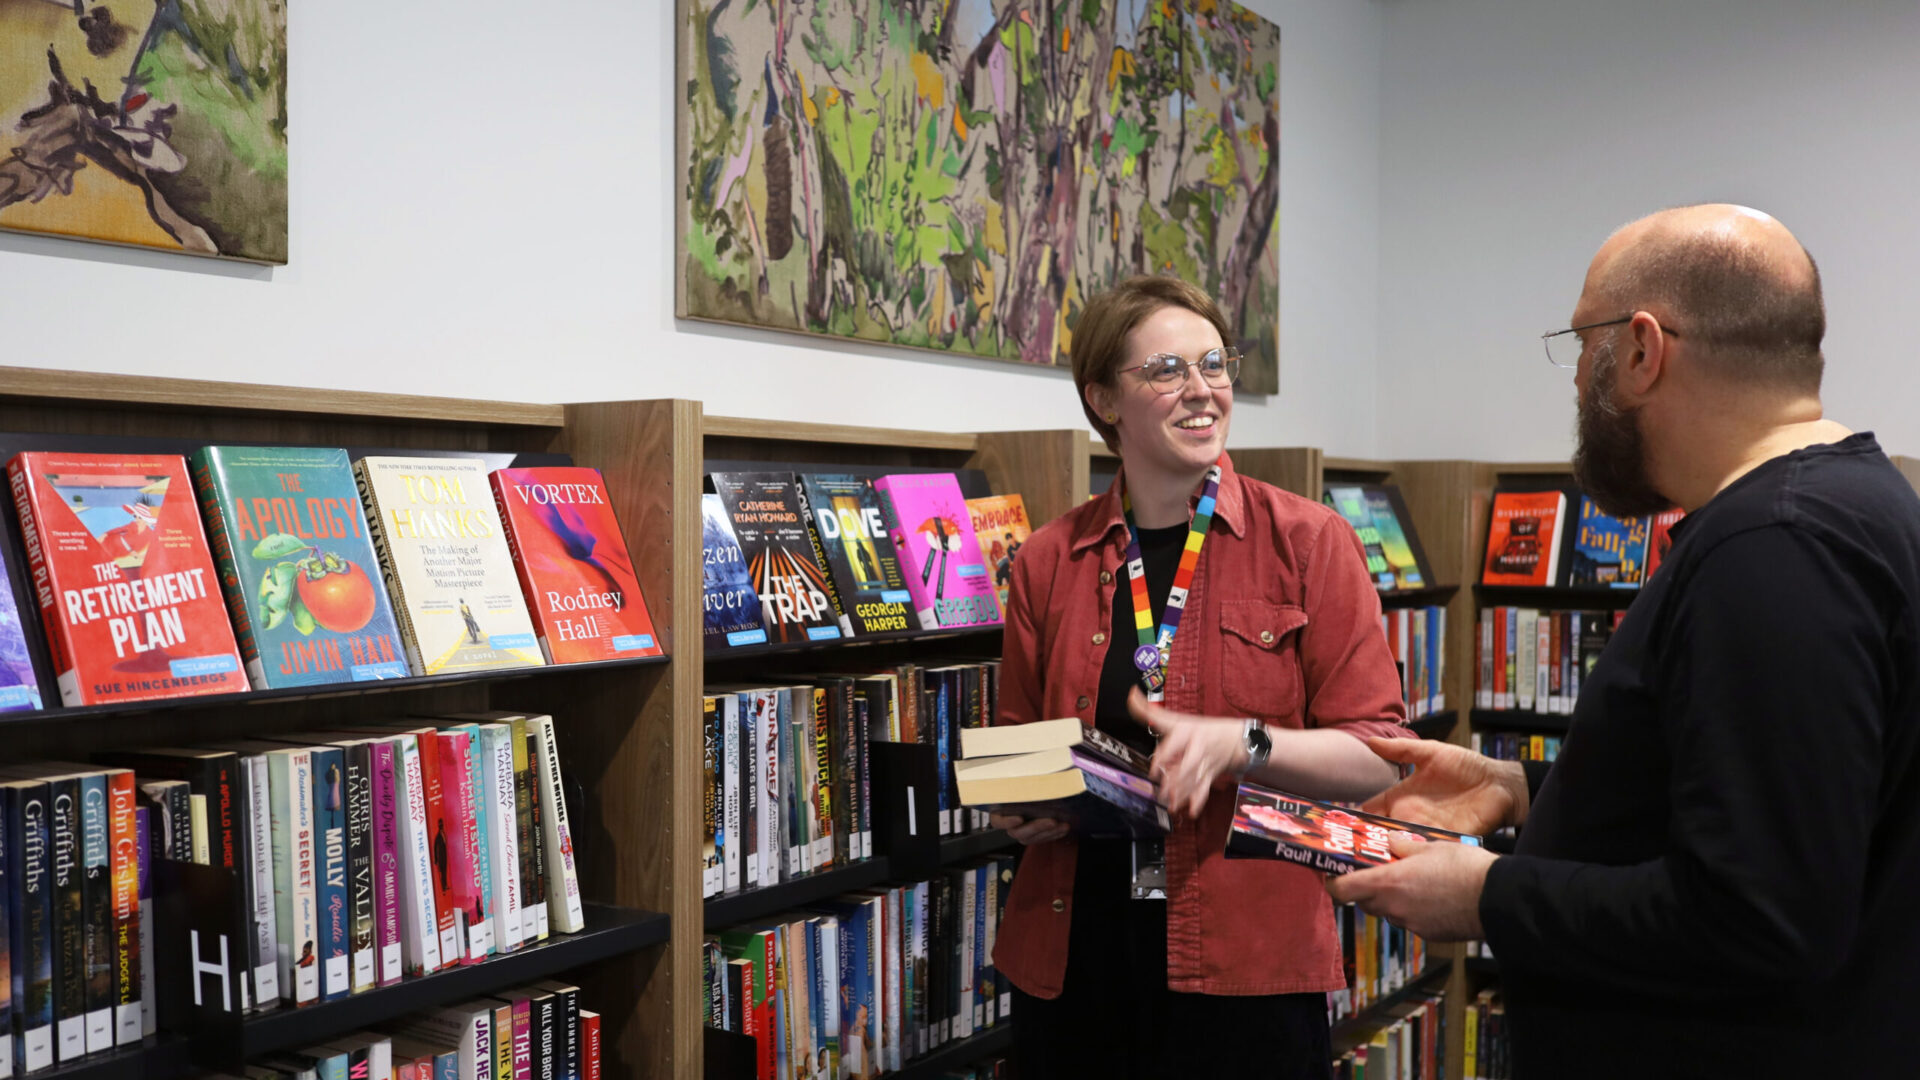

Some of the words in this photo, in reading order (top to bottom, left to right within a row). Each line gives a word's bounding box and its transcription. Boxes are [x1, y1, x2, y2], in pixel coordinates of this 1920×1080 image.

[276, 473, 304, 492] THE
[398, 475, 467, 505] TOM
[514, 484, 604, 505] VORTEX
[236, 498, 363, 541] APOLOGY
[390, 508, 494, 539] HANKS
[733, 512, 758, 524] RYAN
[758, 512, 798, 523] HOWARD
[739, 501, 786, 512] CATHERINE
[817, 508, 887, 539] DOVE
[972, 505, 1023, 533] EMBRACE
[1497, 507, 1556, 517] DISSECTION
[11, 472, 43, 563] RETIREMENT
[34, 566, 54, 609] PLAN
[204, 499, 232, 562] APOLOGY
[354, 467, 372, 510] TOM
[365, 516, 395, 585] HANKS
[796, 483, 813, 524] DOVE
[808, 528, 830, 580] GEORGIA
[1518, 524, 1532, 533] OF
[419, 545, 437, 555] The
[438, 545, 469, 558] Making
[470, 545, 479, 555] of
[423, 556, 456, 567] Another
[457, 556, 482, 568] Major
[1500, 555, 1539, 565] MURDER
[93, 561, 121, 583] THE
[426, 567, 456, 578] Motion
[457, 567, 486, 578] Picture
[434, 579, 484, 591] Masterpiece
[771, 575, 802, 594] THE
[64, 568, 207, 625] RETIREMENT
[546, 587, 622, 613] Rodney
[758, 591, 828, 625] TRAP
[855, 602, 907, 618] GEORGIA
[108, 607, 186, 658] PLAN
[554, 615, 601, 642] Hall
[863, 616, 908, 632] HARPER
[193, 660, 230, 672] Libraries
[280, 637, 344, 675] JIMIN
[349, 634, 396, 667] HAN
[93, 682, 123, 695] SUE
[127, 672, 228, 692] HINCENBERGS
[704, 724, 712, 770] LAKE
[815, 695, 829, 789] SUNSTRUCK
[293, 754, 308, 766] THE
[497, 748, 507, 806] HANNAY
[503, 742, 514, 810] BARBARA
[547, 755, 559, 783] OTHER
[380, 769, 393, 806] Deadly
[406, 762, 419, 823] HANNAY
[412, 756, 425, 825] BARBARA
[459, 782, 468, 819] Kristin
[474, 753, 484, 813] BARBARA
[749, 787, 757, 811] GIRL
[113, 788, 132, 834] John
[220, 784, 232, 828] APOLLO
[253, 784, 264, 821] TESSA
[348, 766, 361, 849] HAMMER
[360, 776, 371, 832] CHRIS
[463, 748, 476, 823] SUMMER
[470, 825, 482, 888] ISLAND
[551, 783, 565, 823] MOTHERS
[25, 800, 43, 894] Griffiths
[55, 794, 72, 888] Griffiths
[85, 787, 103, 880] Griffiths
[417, 830, 425, 854] THE
[462, 820, 471, 860] Hannah
[503, 813, 512, 847] Second
[1324, 820, 1355, 856] Fault
[1360, 824, 1392, 861] Lines
[255, 822, 267, 875] HADLEY
[299, 830, 311, 889] SECRET
[326, 827, 344, 888] MOLLY
[353, 855, 370, 867] THE
[505, 846, 514, 877] Chance
[1275, 842, 1313, 865] Fault
[1315, 853, 1356, 875] Lines
[116, 837, 134, 920] Grisham
[384, 870, 396, 903] AMANDA
[418, 856, 430, 894] WIFE'S
[258, 894, 267, 917] THE
[354, 867, 373, 954] VALLEY
[507, 878, 517, 914] FAMIL
[119, 924, 128, 945] THE
[259, 918, 270, 953] PAST
[330, 894, 343, 943] Rosalie
[385, 904, 397, 945] HAMPSON
[118, 948, 129, 997] JUDGE'S
[190, 929, 232, 1012] H
[567, 993, 575, 1012] THE
[712, 982, 721, 1000] LISA
[542, 1003, 553, 1027] KILL
[744, 987, 753, 1035] RESIDENT
[476, 1019, 489, 1058] JACK
[500, 1039, 511, 1068] THE
[514, 1030, 530, 1064] THE
[542, 1027, 553, 1056] YOUR
[567, 1016, 576, 1058] SUMMER
[591, 1028, 599, 1057] Anita
